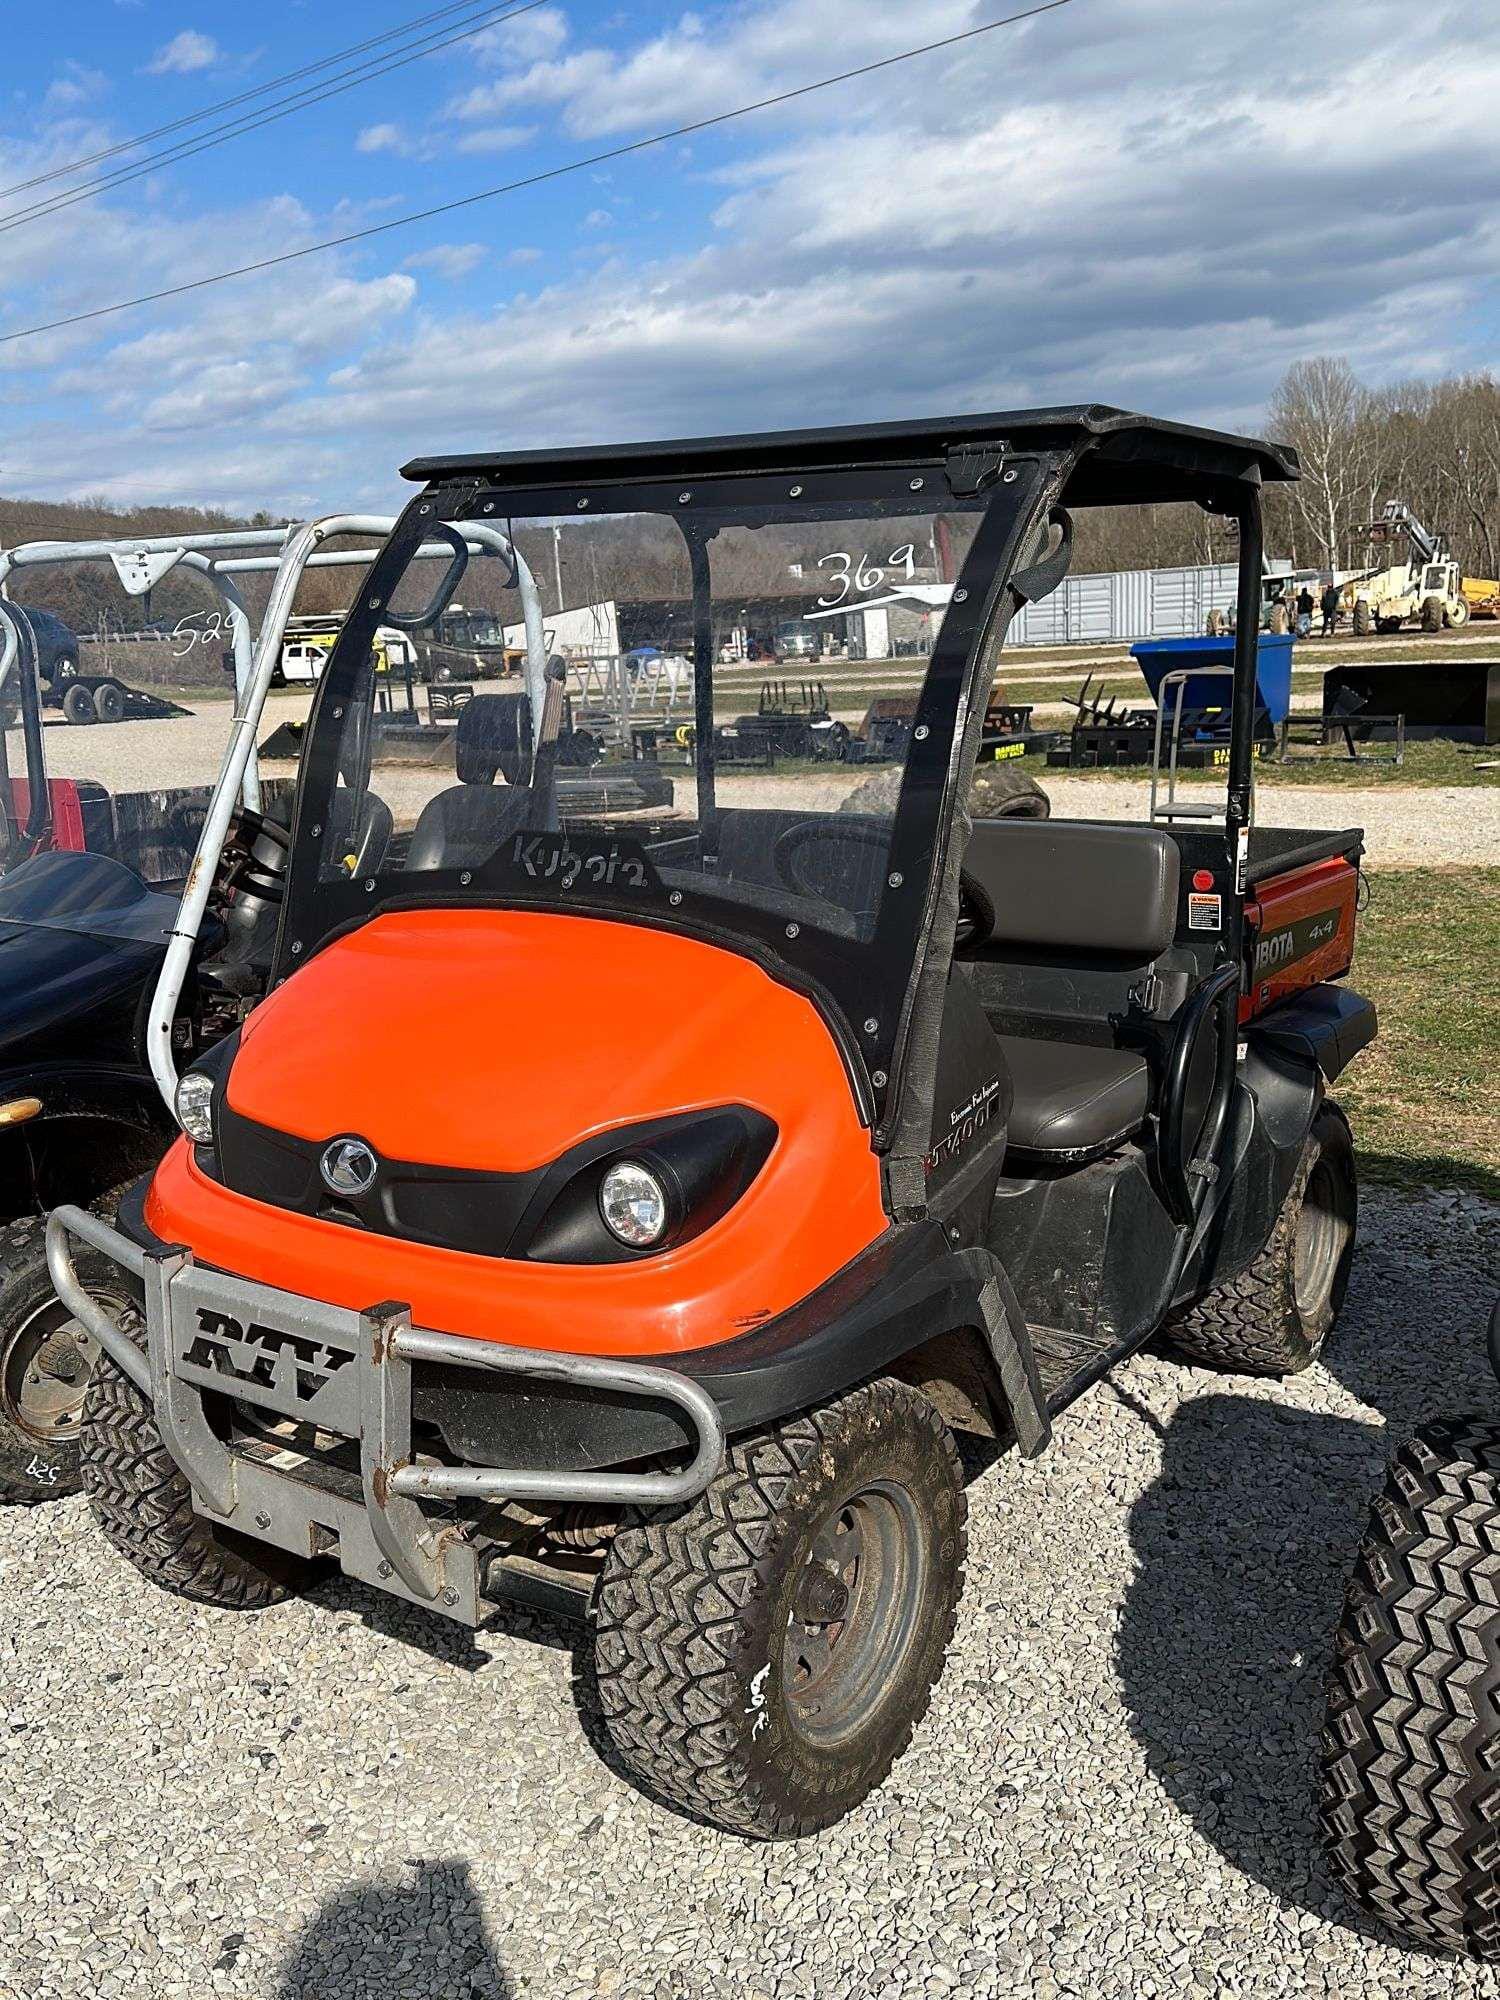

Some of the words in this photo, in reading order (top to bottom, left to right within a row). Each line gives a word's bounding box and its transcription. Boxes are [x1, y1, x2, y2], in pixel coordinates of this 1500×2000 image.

[817, 544, 915, 606] 369
[172, 610, 240, 657] 529
[512, 835, 645, 887] Kubota
[181, 1306, 358, 1402] RTV
